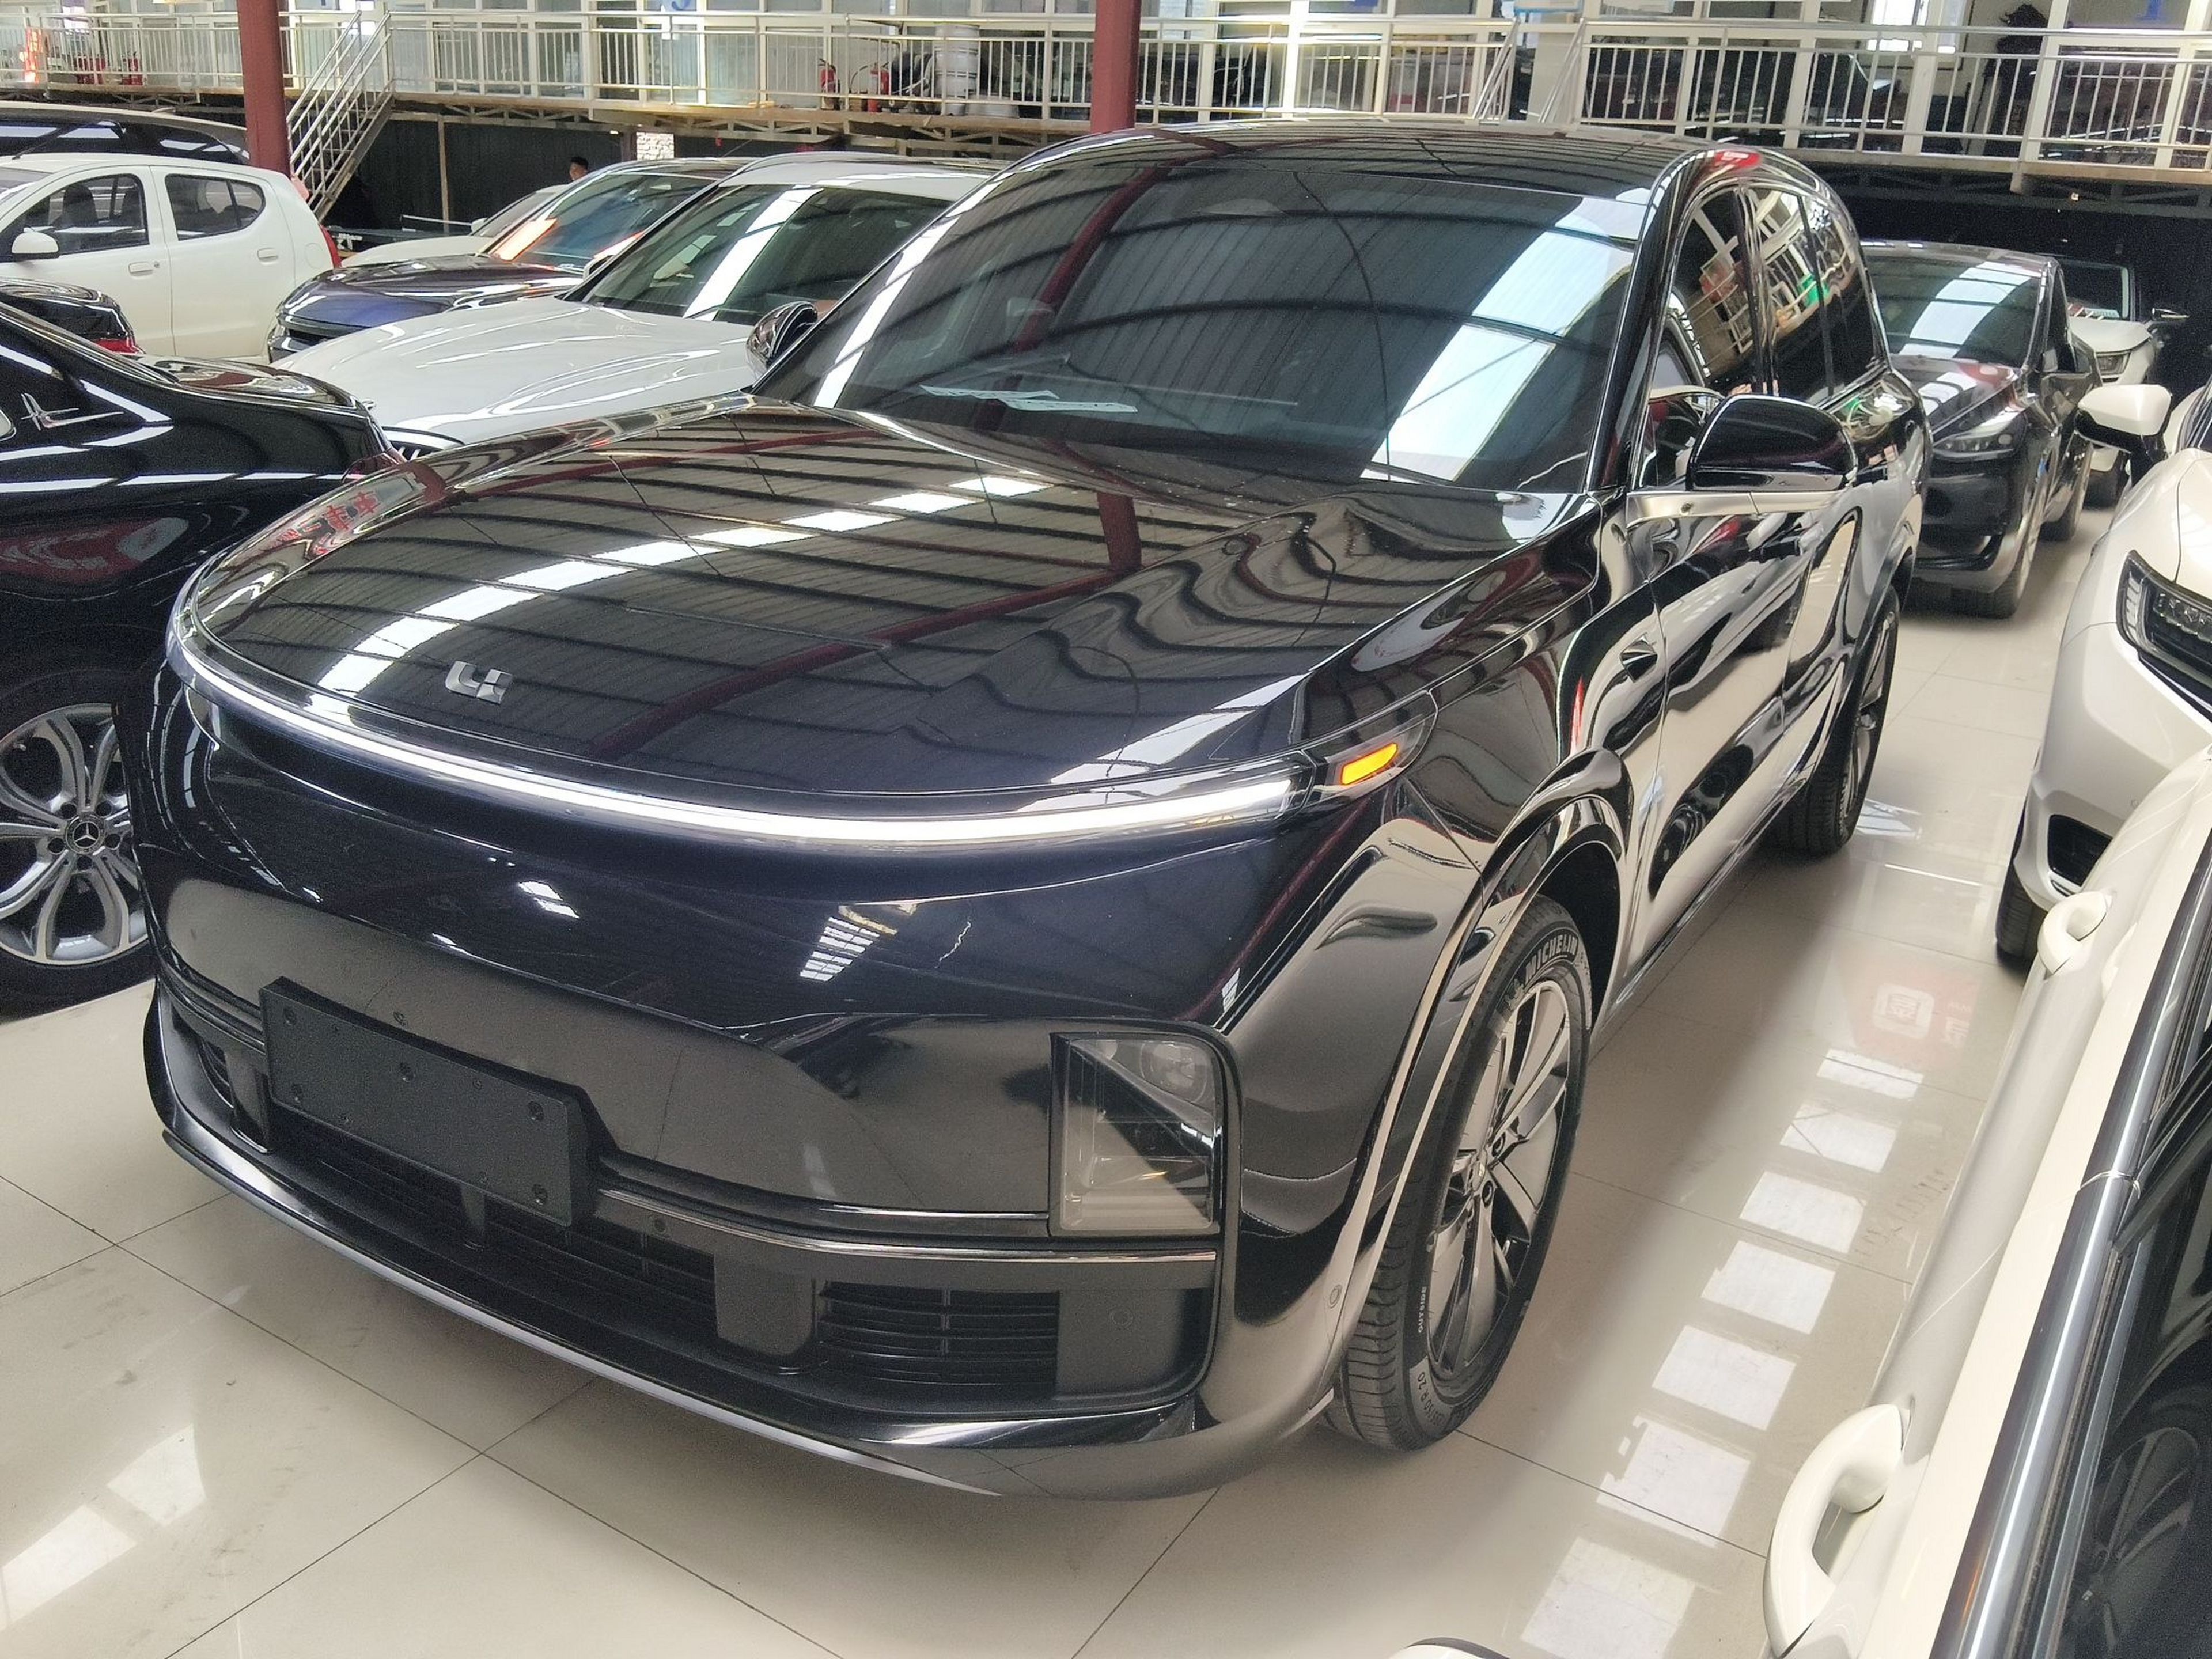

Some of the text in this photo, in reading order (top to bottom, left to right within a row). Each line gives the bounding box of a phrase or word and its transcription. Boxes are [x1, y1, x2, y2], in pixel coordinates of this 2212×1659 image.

[1525, 934, 1578, 983] MICHELIN
[1417, 1286, 1427, 1333] OUTSIDE
[1417, 1371, 1427, 1390] 20
